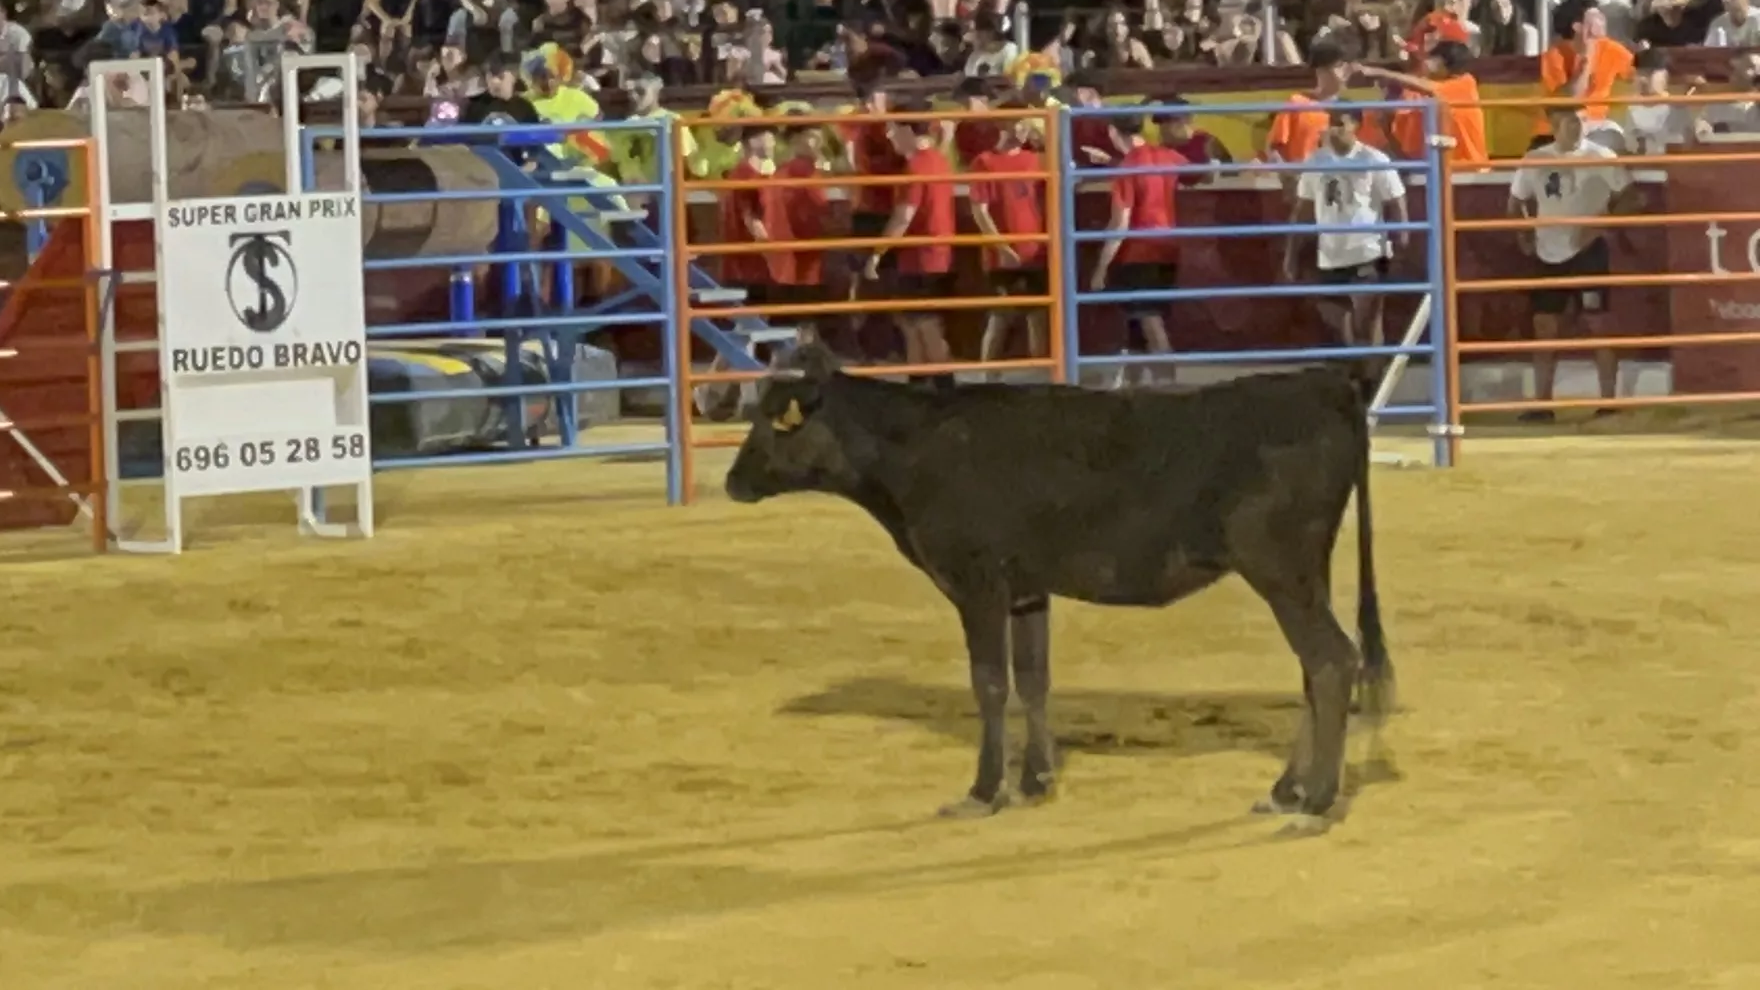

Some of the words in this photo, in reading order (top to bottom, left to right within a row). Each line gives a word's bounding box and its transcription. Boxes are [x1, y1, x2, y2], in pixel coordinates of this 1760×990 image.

[168, 203, 238, 228] SUPER
[244, 200, 302, 224] GRAN
[308, 197, 357, 219] PRIX
[172, 345, 264, 373] RUEDO
[274, 340, 362, 368] BRAVO
[175, 442, 230, 473] 696
[239, 440, 275, 468] 05
[286, 436, 321, 463] 28
[331, 433, 365, 460] 58
